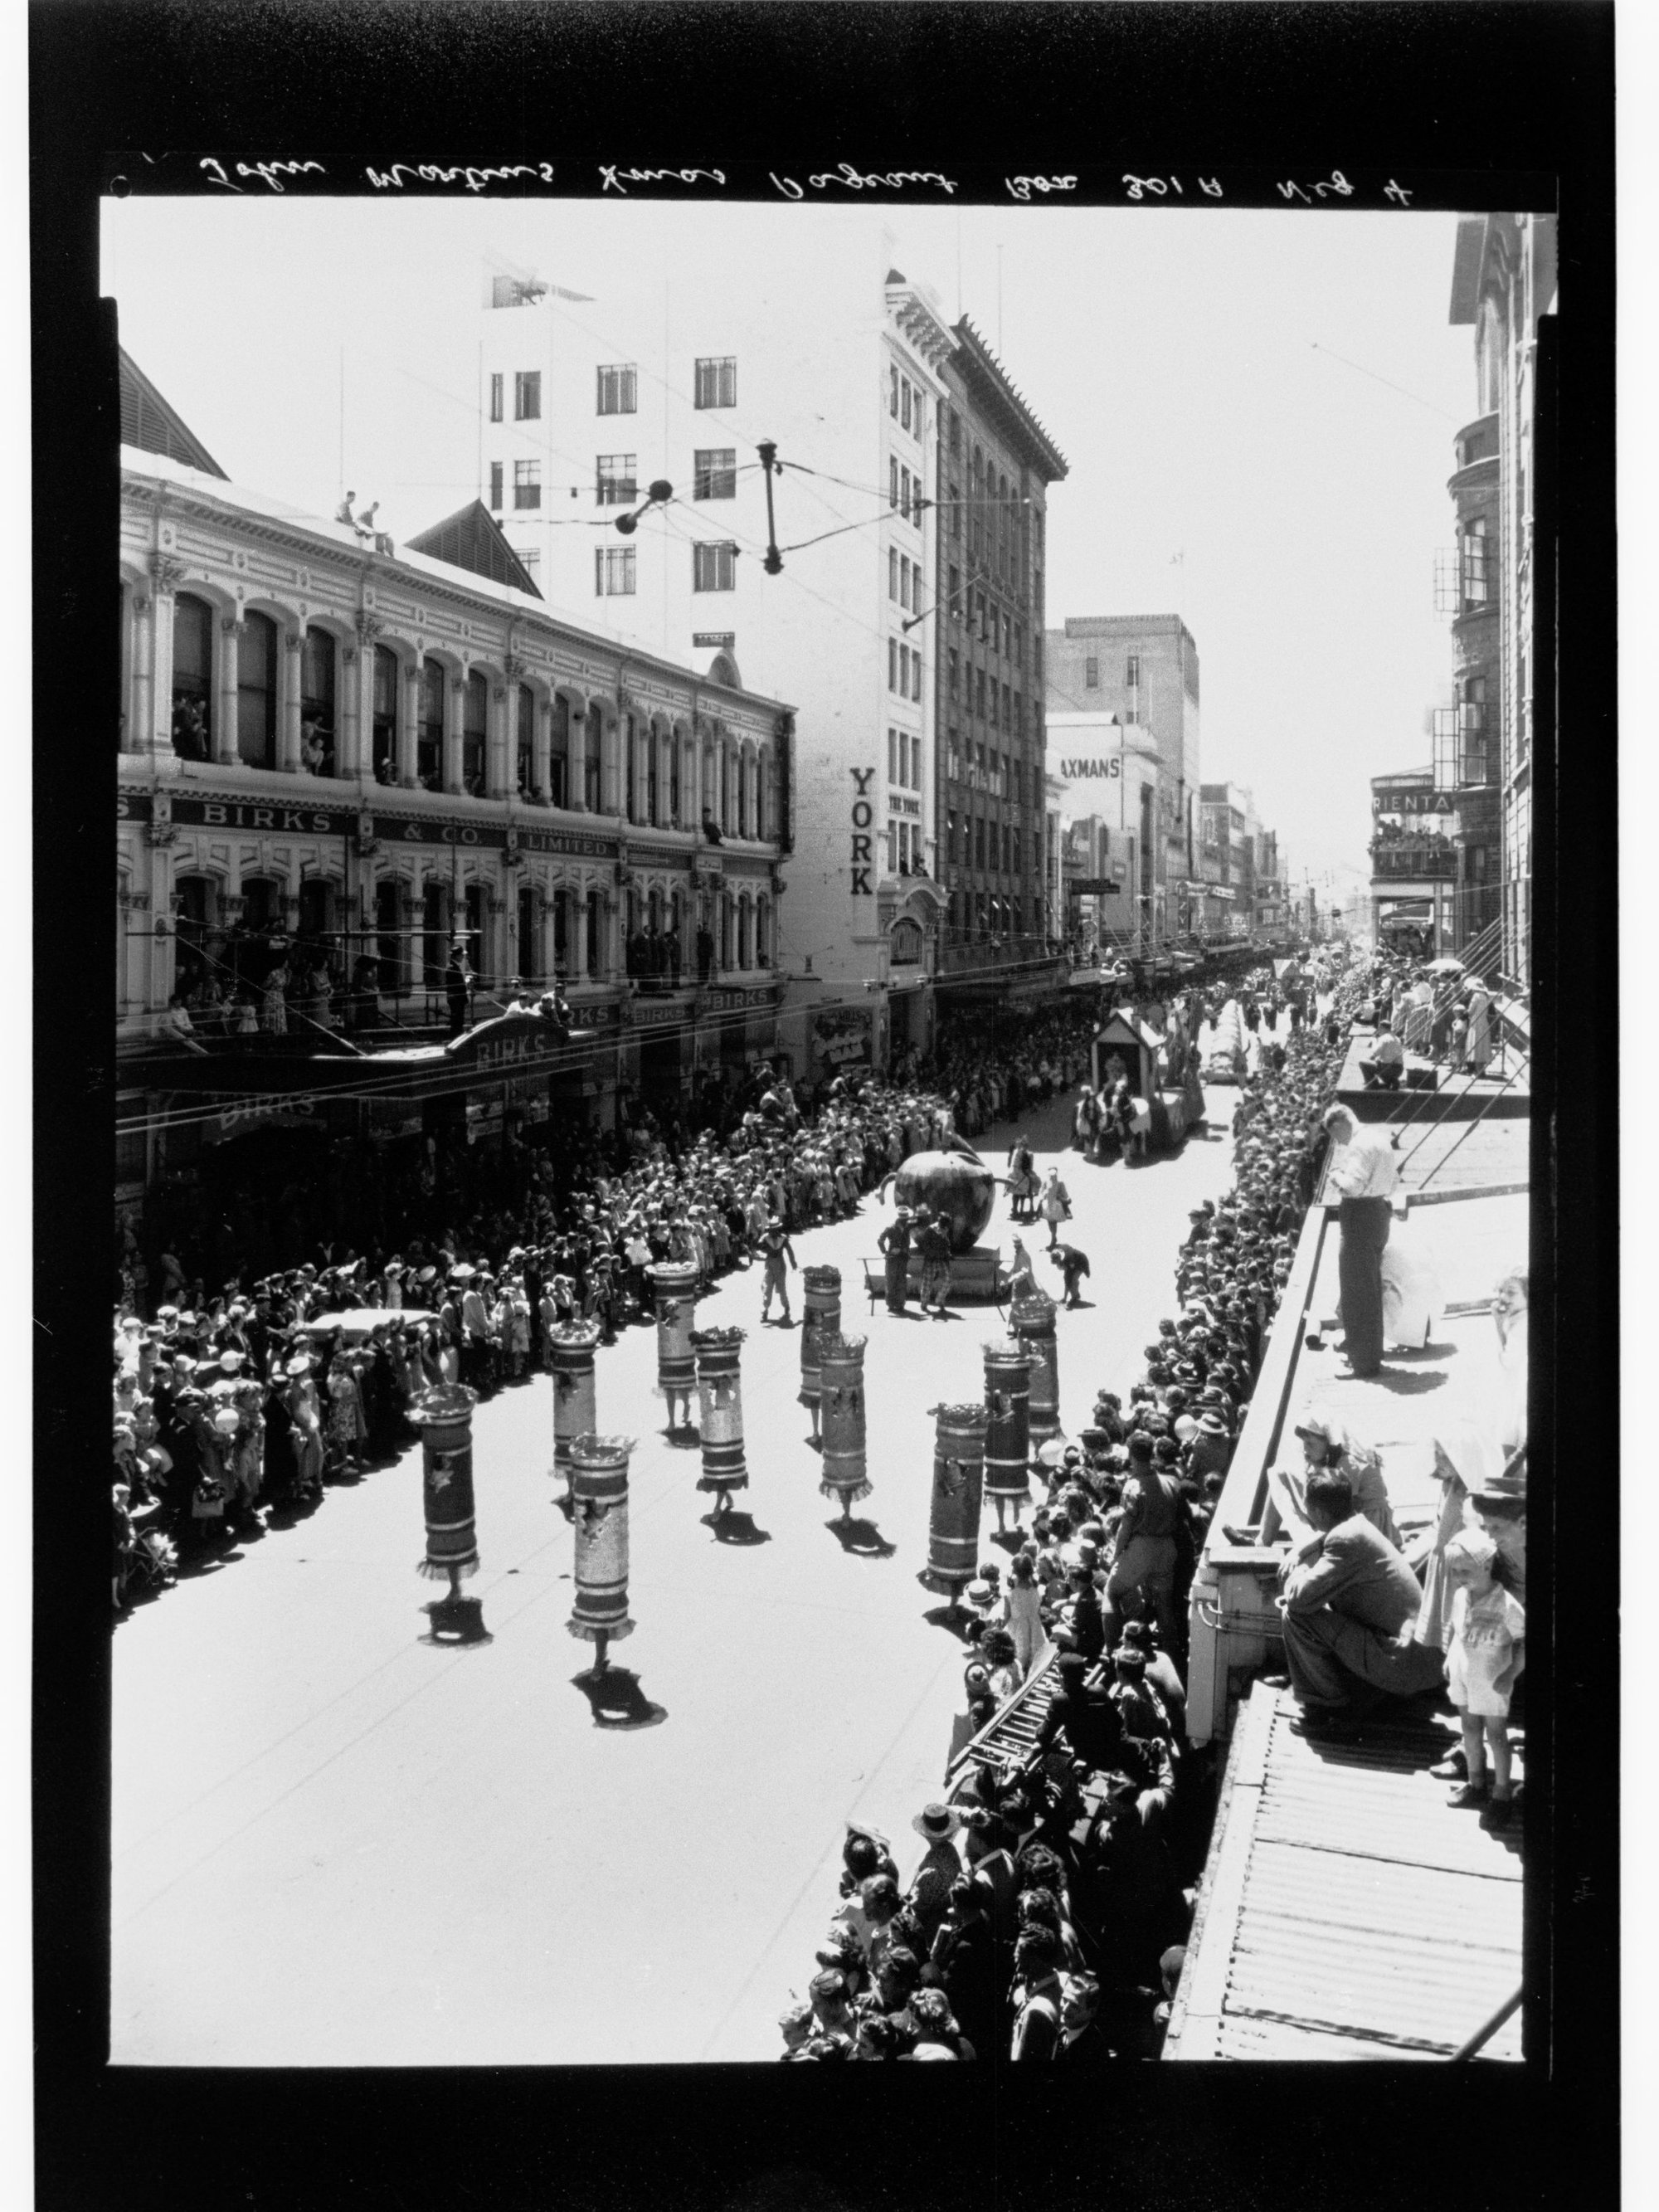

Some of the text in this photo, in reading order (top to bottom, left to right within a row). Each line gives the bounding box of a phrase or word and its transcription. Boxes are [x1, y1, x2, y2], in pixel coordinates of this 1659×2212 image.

[203, 802, 333, 831] BIRKS
[404, 822, 424, 840] &
[528, 832, 608, 856] LIMITED
[850, 767, 876, 896] YORK
[633, 1007, 686, 1024] BIRKS
[713, 989, 768, 1010] BIRKS
[476, 1034, 545, 1071] BIRKS
